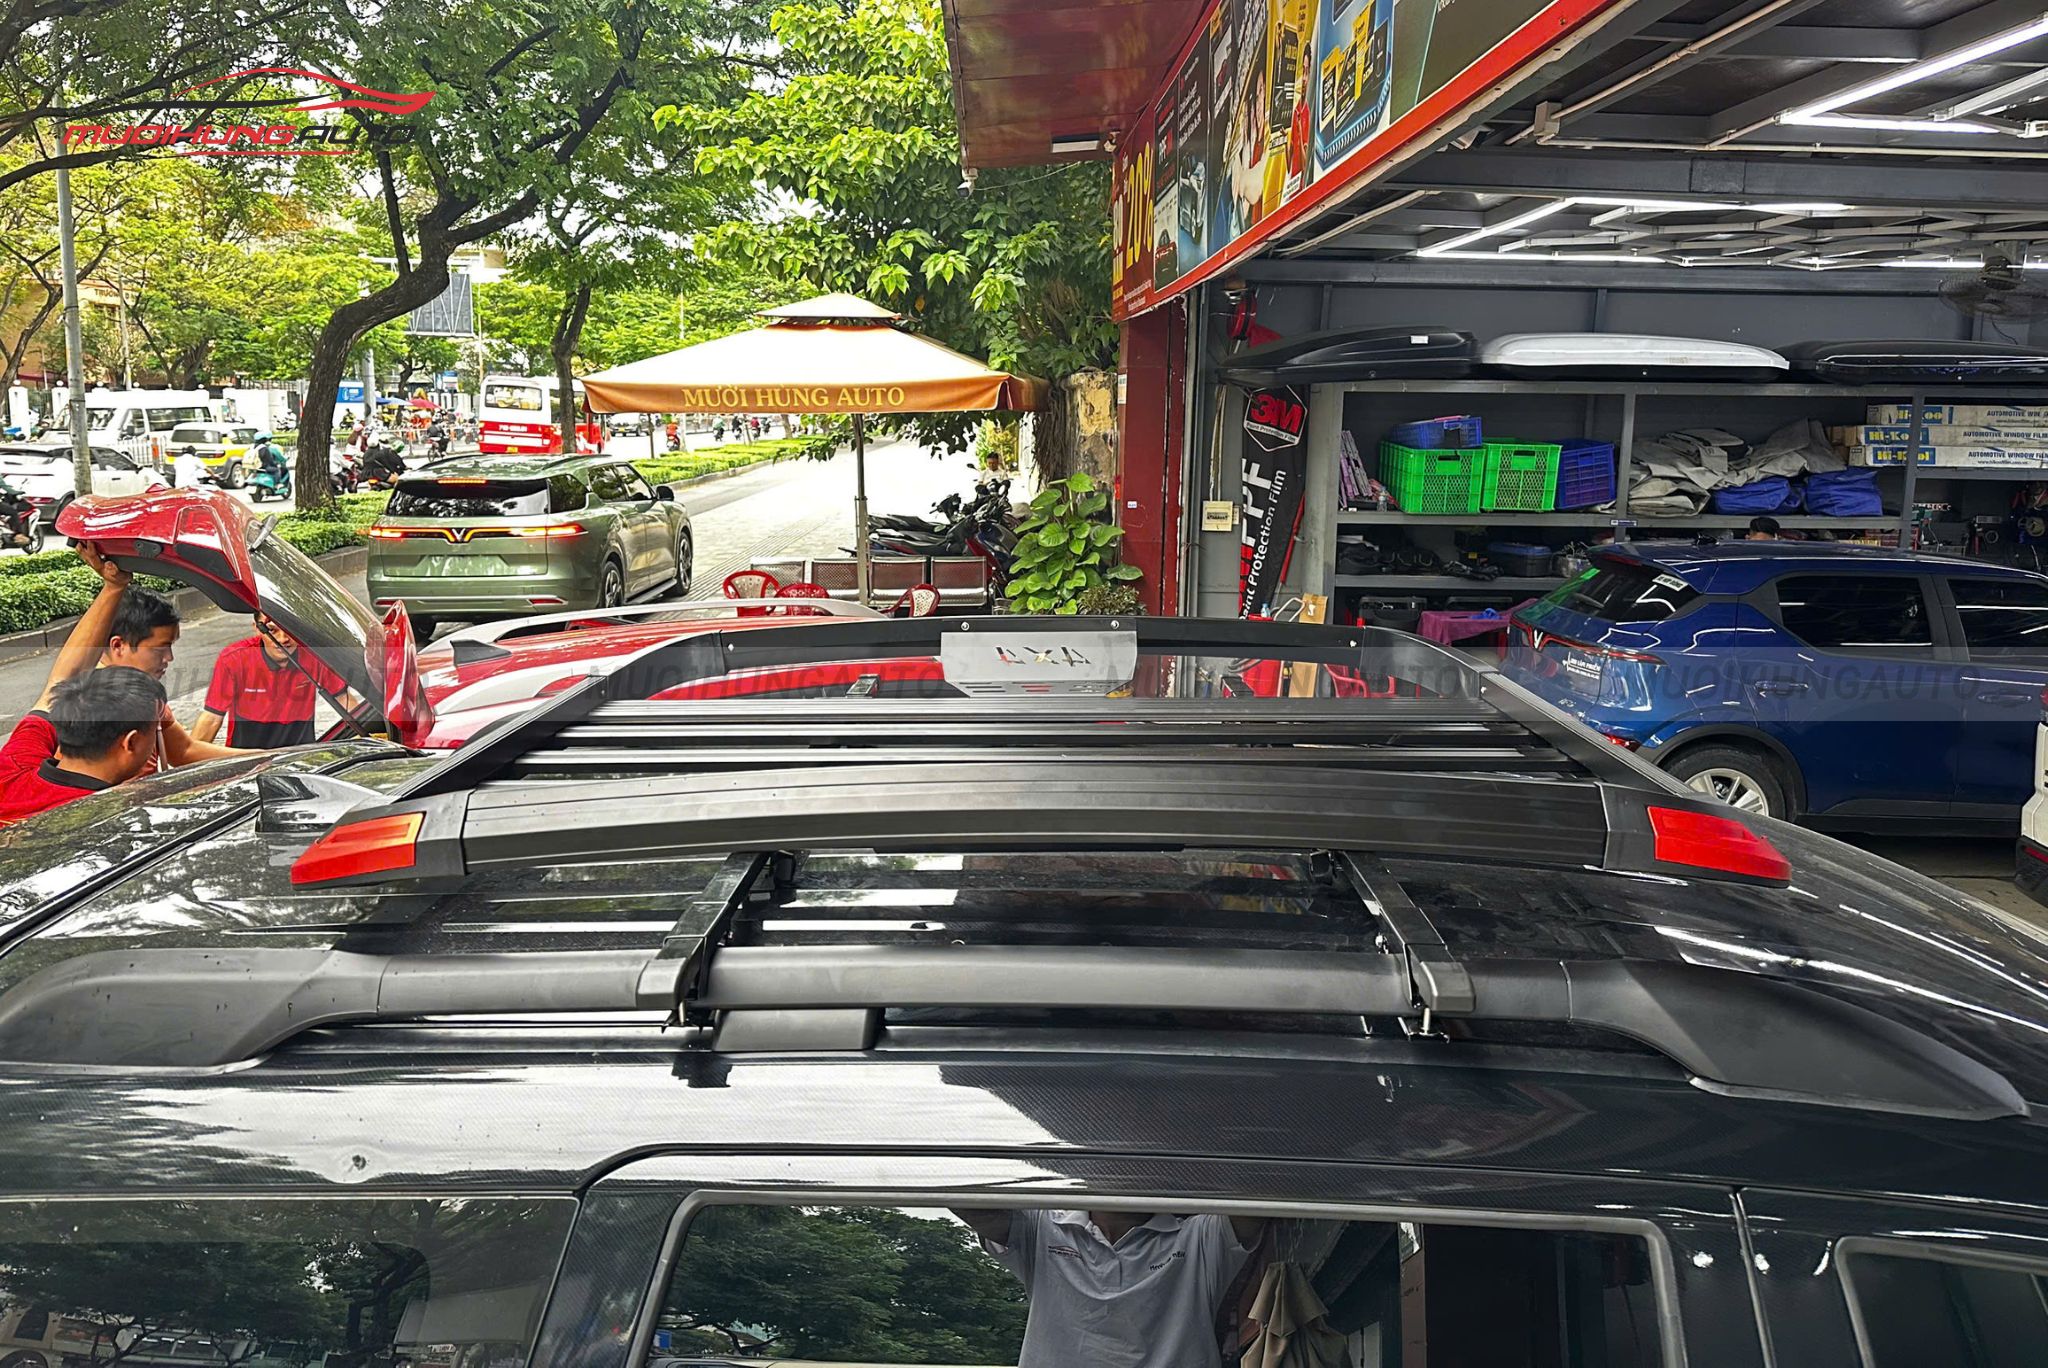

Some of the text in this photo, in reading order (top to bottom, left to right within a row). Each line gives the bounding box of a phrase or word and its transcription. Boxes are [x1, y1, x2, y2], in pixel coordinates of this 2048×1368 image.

[1126, 141, 1154, 270] 20%
[682, 384, 905, 408] MƯỜI HÙNG AUTO
[1251, 394, 1303, 434] 3M
[1247, 504, 1276, 586] Protection
[1268, 469, 1287, 503] Film
